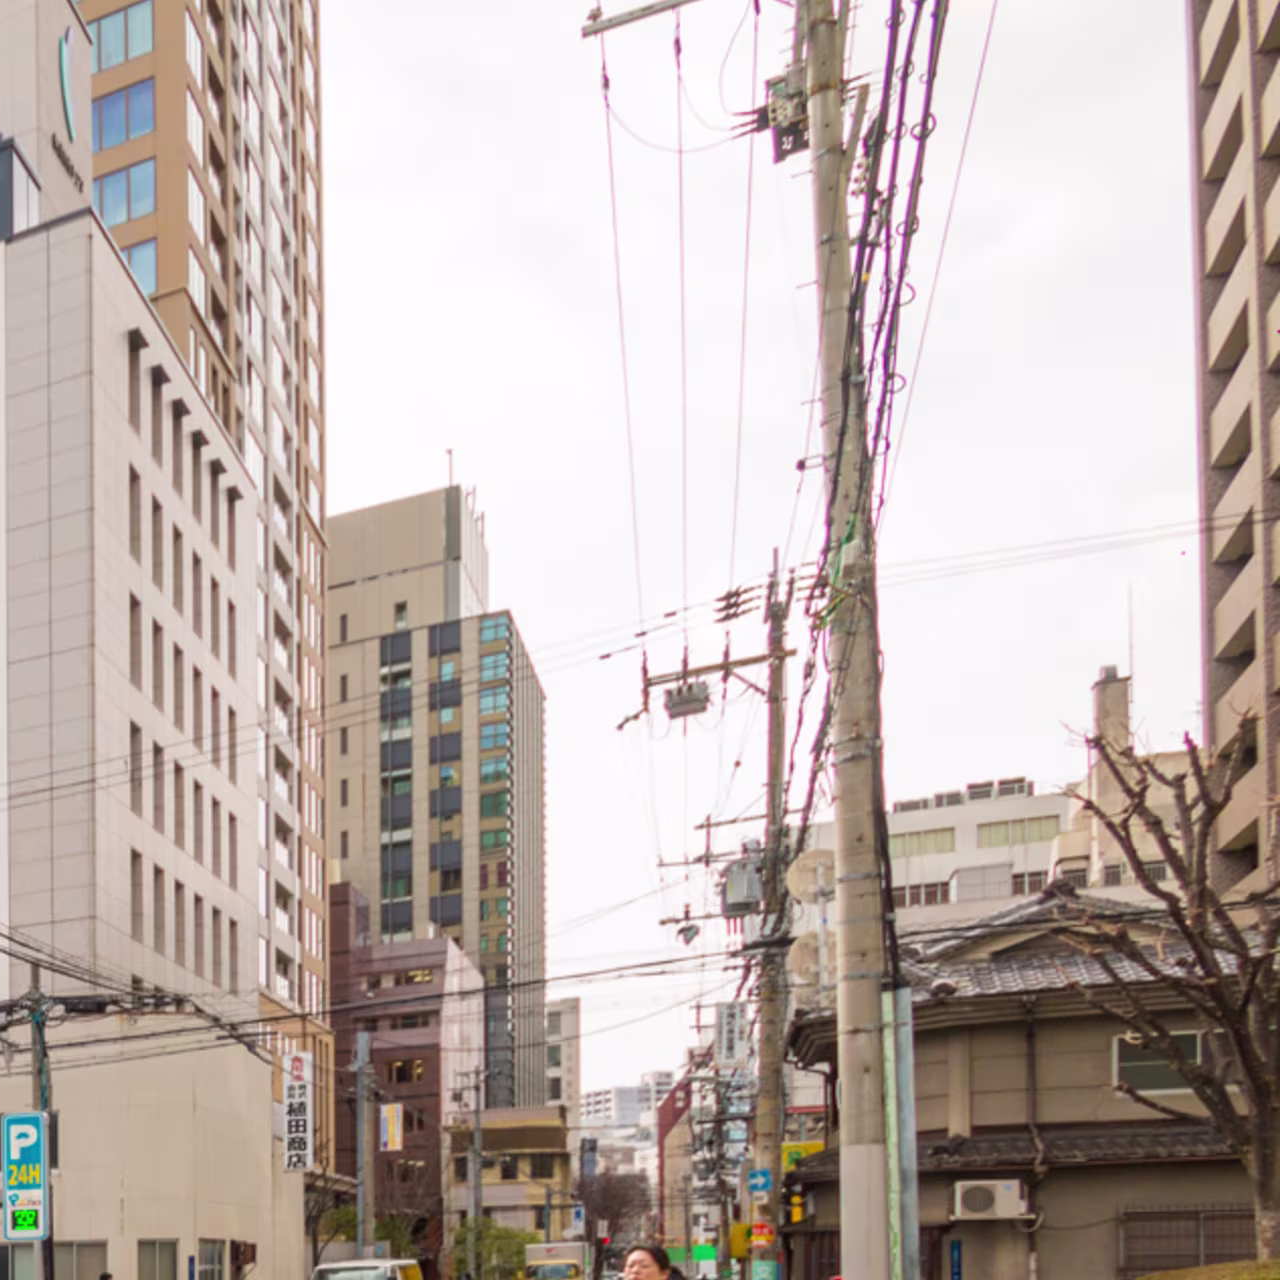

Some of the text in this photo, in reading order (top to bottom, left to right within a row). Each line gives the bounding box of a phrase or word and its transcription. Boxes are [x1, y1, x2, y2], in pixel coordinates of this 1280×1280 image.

[9, 1124, 38, 1160] P
[286, 1101, 308, 1169] 植田商店
[8, 1163, 41, 1187] 24H
